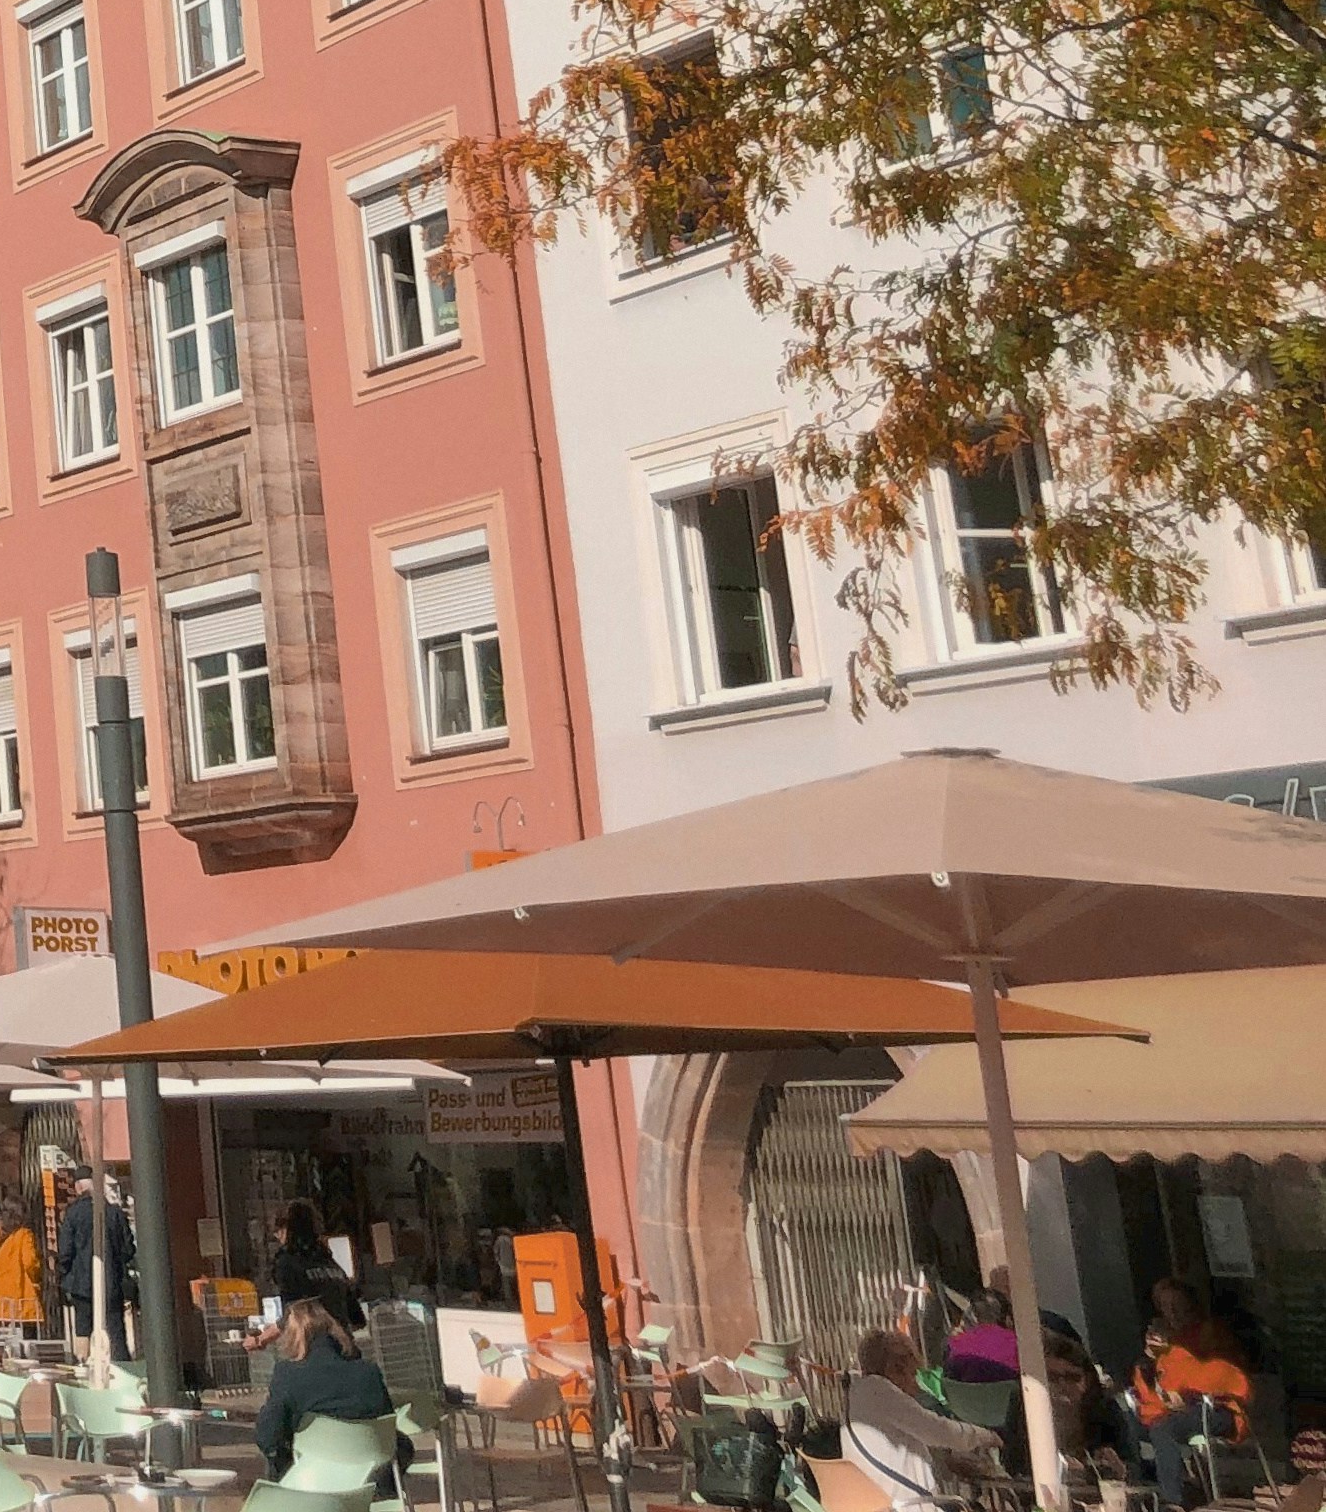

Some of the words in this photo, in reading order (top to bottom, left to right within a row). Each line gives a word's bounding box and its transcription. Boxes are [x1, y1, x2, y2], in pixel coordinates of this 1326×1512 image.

[31, 916, 99, 934] PHOTO
[32, 935, 98, 952] PORST
[428, 1089, 471, 1108] Pass-
[476, 1088, 505, 1107] und
